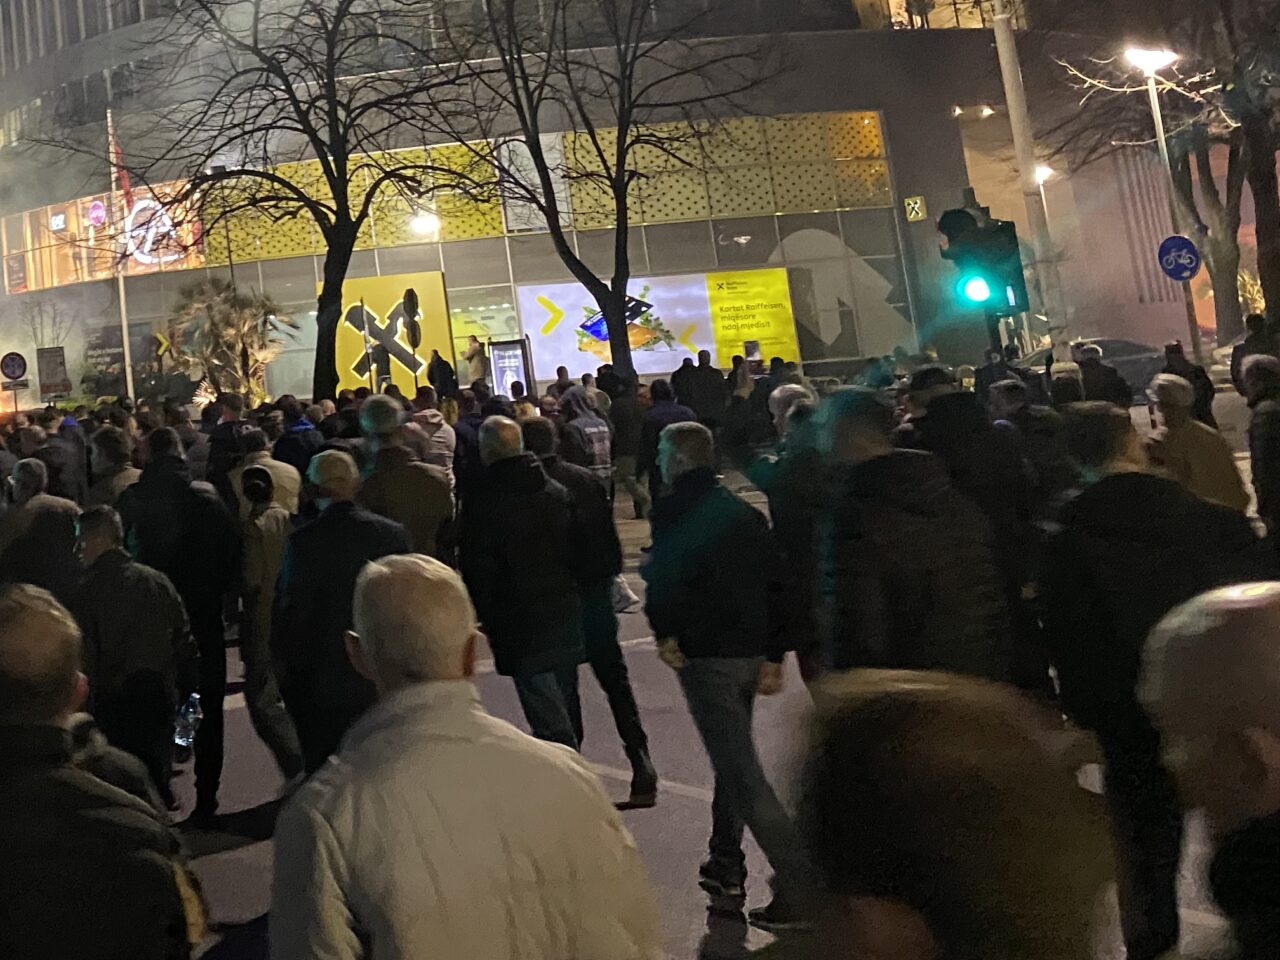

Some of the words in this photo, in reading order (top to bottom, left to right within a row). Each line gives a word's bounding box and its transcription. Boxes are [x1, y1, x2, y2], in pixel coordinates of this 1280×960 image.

[719, 305, 744, 313] Kartat
[722, 323, 740, 332] ndaj
[740, 320, 771, 330] mjedisit
